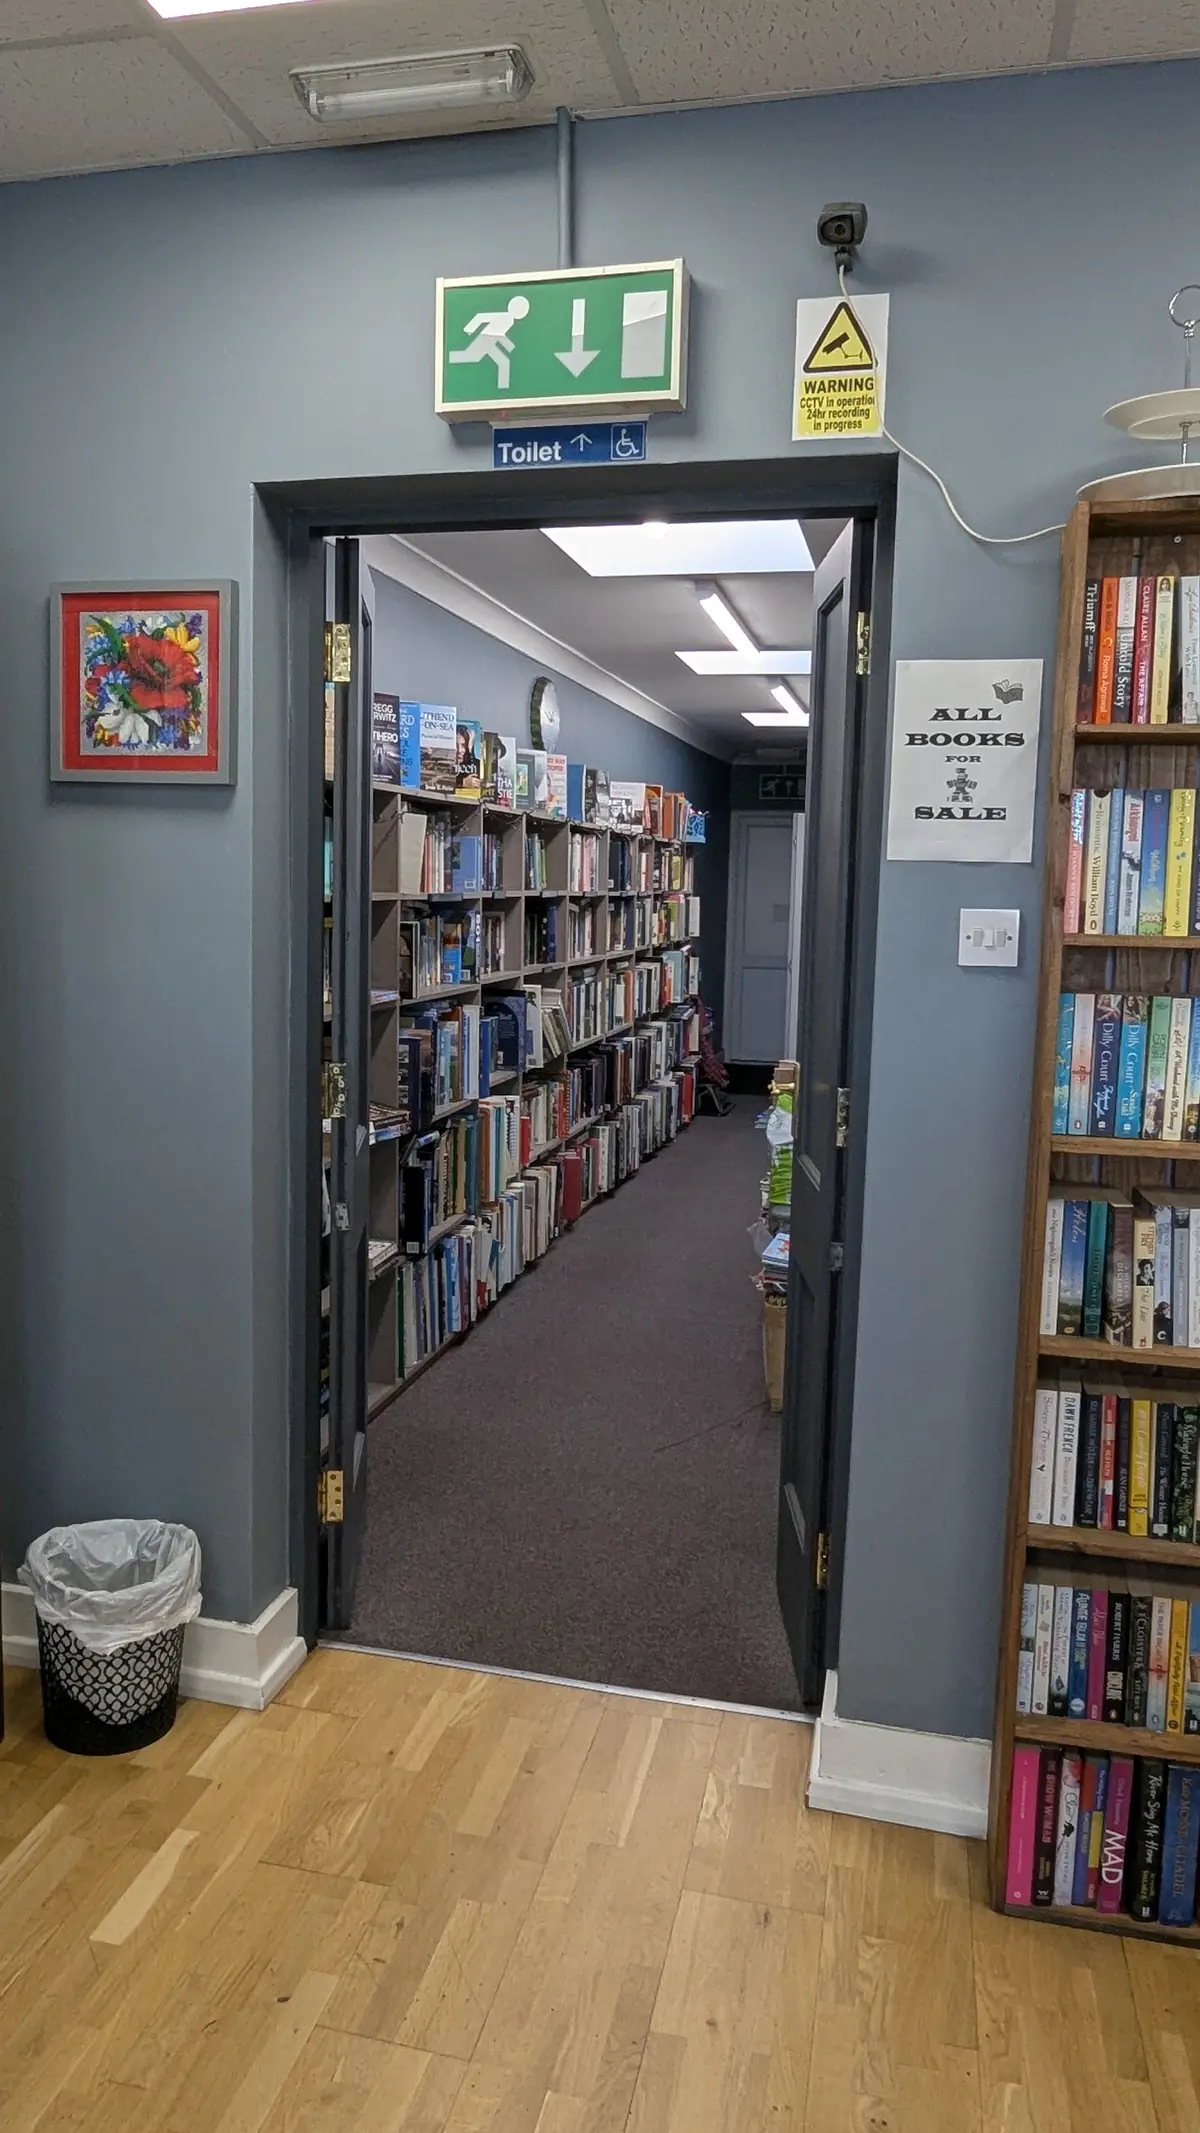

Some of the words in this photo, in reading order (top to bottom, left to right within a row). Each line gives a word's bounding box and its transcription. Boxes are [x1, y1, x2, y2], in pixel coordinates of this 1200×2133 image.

[804, 377, 874, 395] WARNING
[800, 397, 824, 409] CCTV
[826, 397, 834, 407] in
[807, 409, 826, 420] 24hr
[828, 407, 870, 419] recording
[813, 421, 822, 431] in
[824, 419, 862, 432] progress
[497, 440, 562, 464] Toilet
[1085, 583, 1098, 633] Triumff
[1142, 585, 1151, 613] CLAIRE
[1141, 615, 1150, 642] ALLAN
[1118, 632, 1134, 673] Untold
[1138, 661, 1147, 677] THE
[1114, 676, 1129, 708] Story
[373, 703, 394, 713] REGG
[374, 713, 397, 723] RWITZ
[928, 708, 1002, 721] ALL
[904, 732, 1025, 747] BOOKS
[944, 755, 982, 763] FOR
[914, 806, 1007, 821] SALE
[1093, 810, 1104, 853] Romantic
[1090, 856, 1101, 891] William
[1088, 893, 1098, 917] Boyd
[1099, 1023, 1114, 1049] Dilly
[1127, 1024, 1140, 1048] Dilly
[1099, 1051, 1112, 1082] Court
[1125, 1053, 1138, 1083] Court
[1072, 1205, 1086, 1243] Helen
[1140, 1233, 1148, 1247] FRY
[1064, 1397, 1077, 1420] DAWN
[1062, 1423, 1076, 1454] FRENCH
[1114, 1602, 1123, 1631] ROBERT
[1046, 1774, 1056, 1804] SHOW
[1148, 1775, 1163, 1798] River
[1144, 1800, 1160, 1820] Sing
[1176, 1800, 1189, 1837] MOSSE
[1042, 1806, 1054, 1843] WOMAN
[1144, 1822, 1159, 1837] Me
[1101, 1829, 1126, 1885] MAD
[1145, 1840, 1158, 1863] Home
[1172, 1844, 1186, 1898] CITADEL
